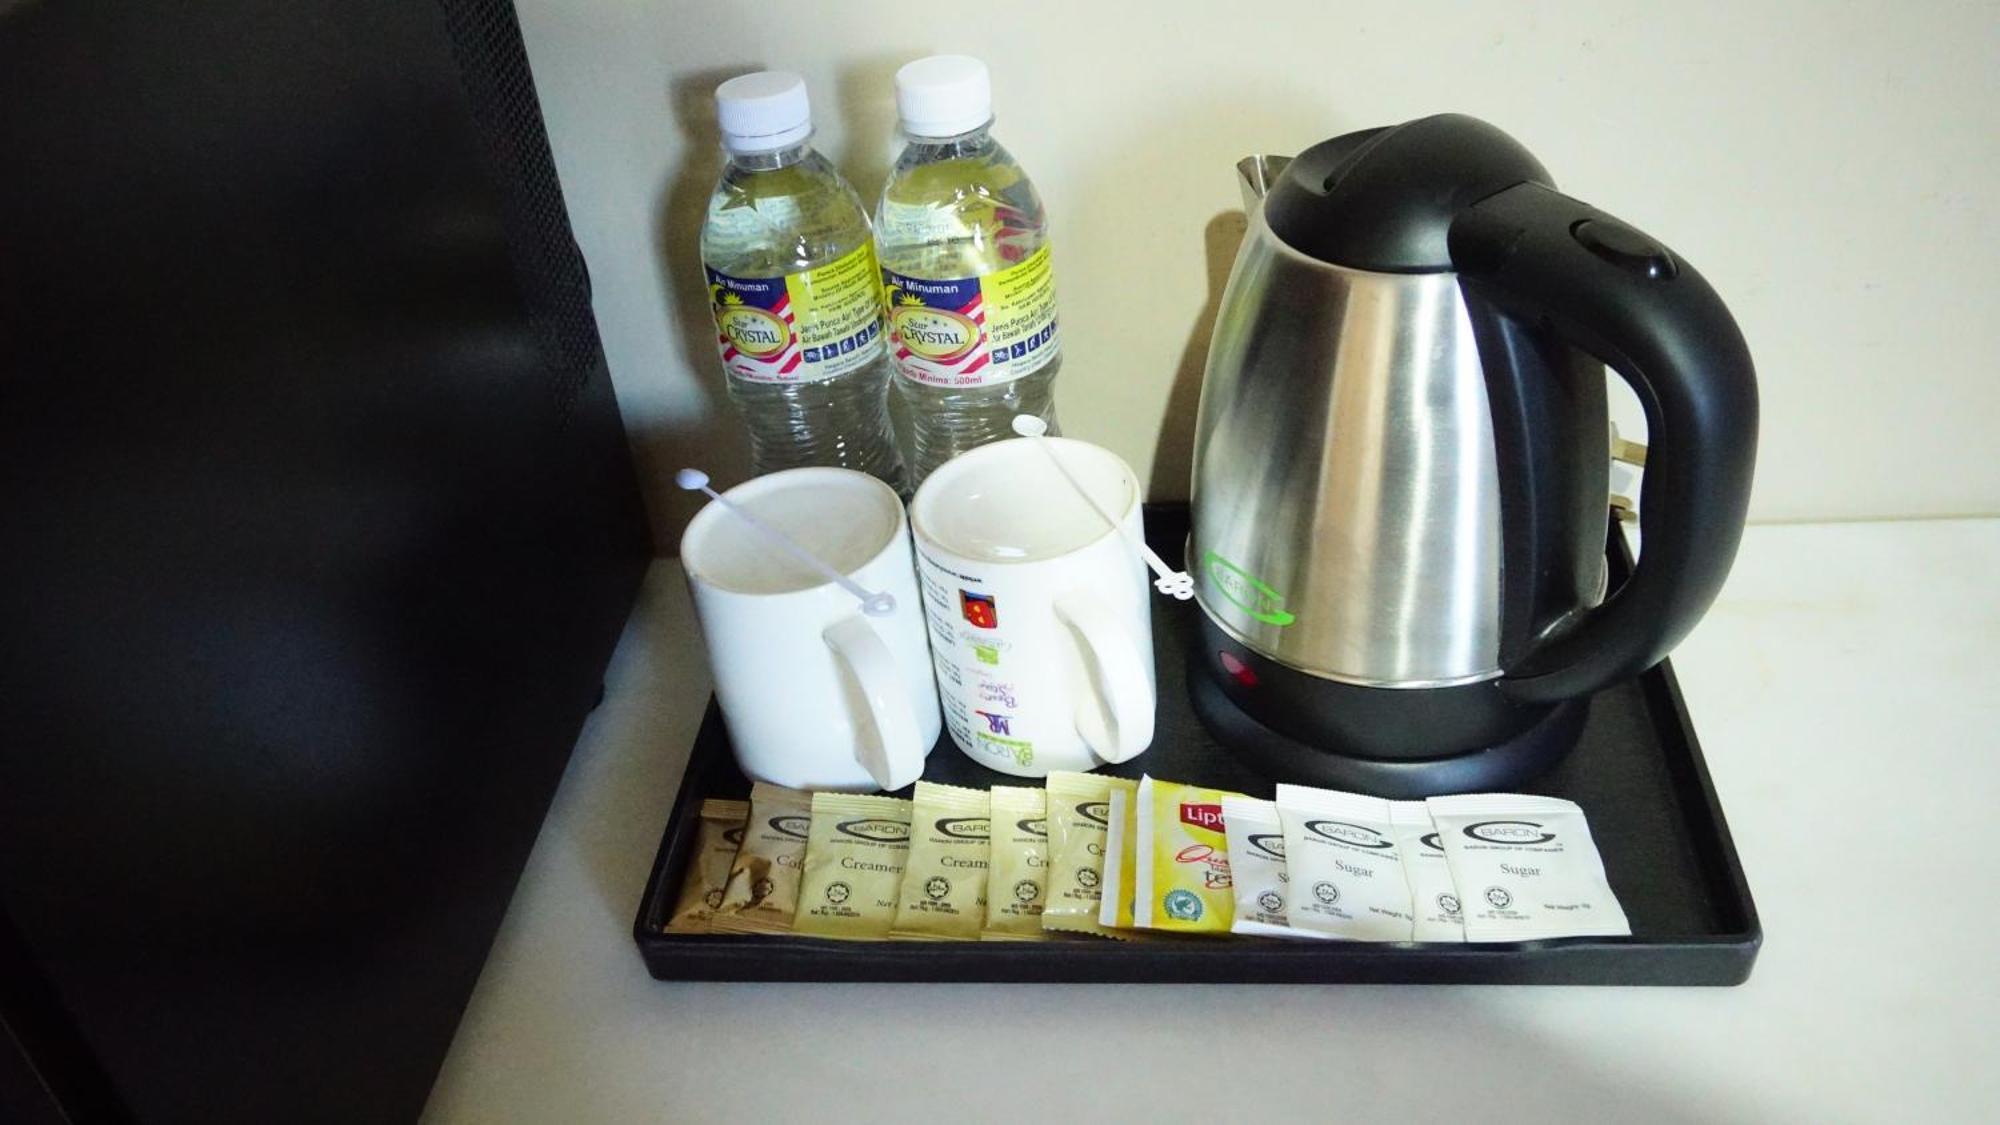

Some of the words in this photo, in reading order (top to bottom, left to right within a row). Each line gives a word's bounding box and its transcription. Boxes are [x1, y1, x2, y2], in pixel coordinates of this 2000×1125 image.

[727, 281, 770, 293] Minuman
[891, 275, 904, 287] Air
[906, 281, 960, 295] Minuman
[908, 318, 929, 331] Star
[992, 321, 1010, 335] Jenis
[727, 324, 781, 345] CRYSTAL
[901, 325, 965, 346] CRYSTAL
[954, 376, 983, 386] 500ml
[854, 824, 907, 836] BARON
[1320, 824, 1378, 843] BARON
[1480, 828, 1539, 838] BARON
[841, 856, 904, 874] Creamer
[1335, 859, 1375, 878] Sugar
[1499, 863, 1541, 878] Sugar
